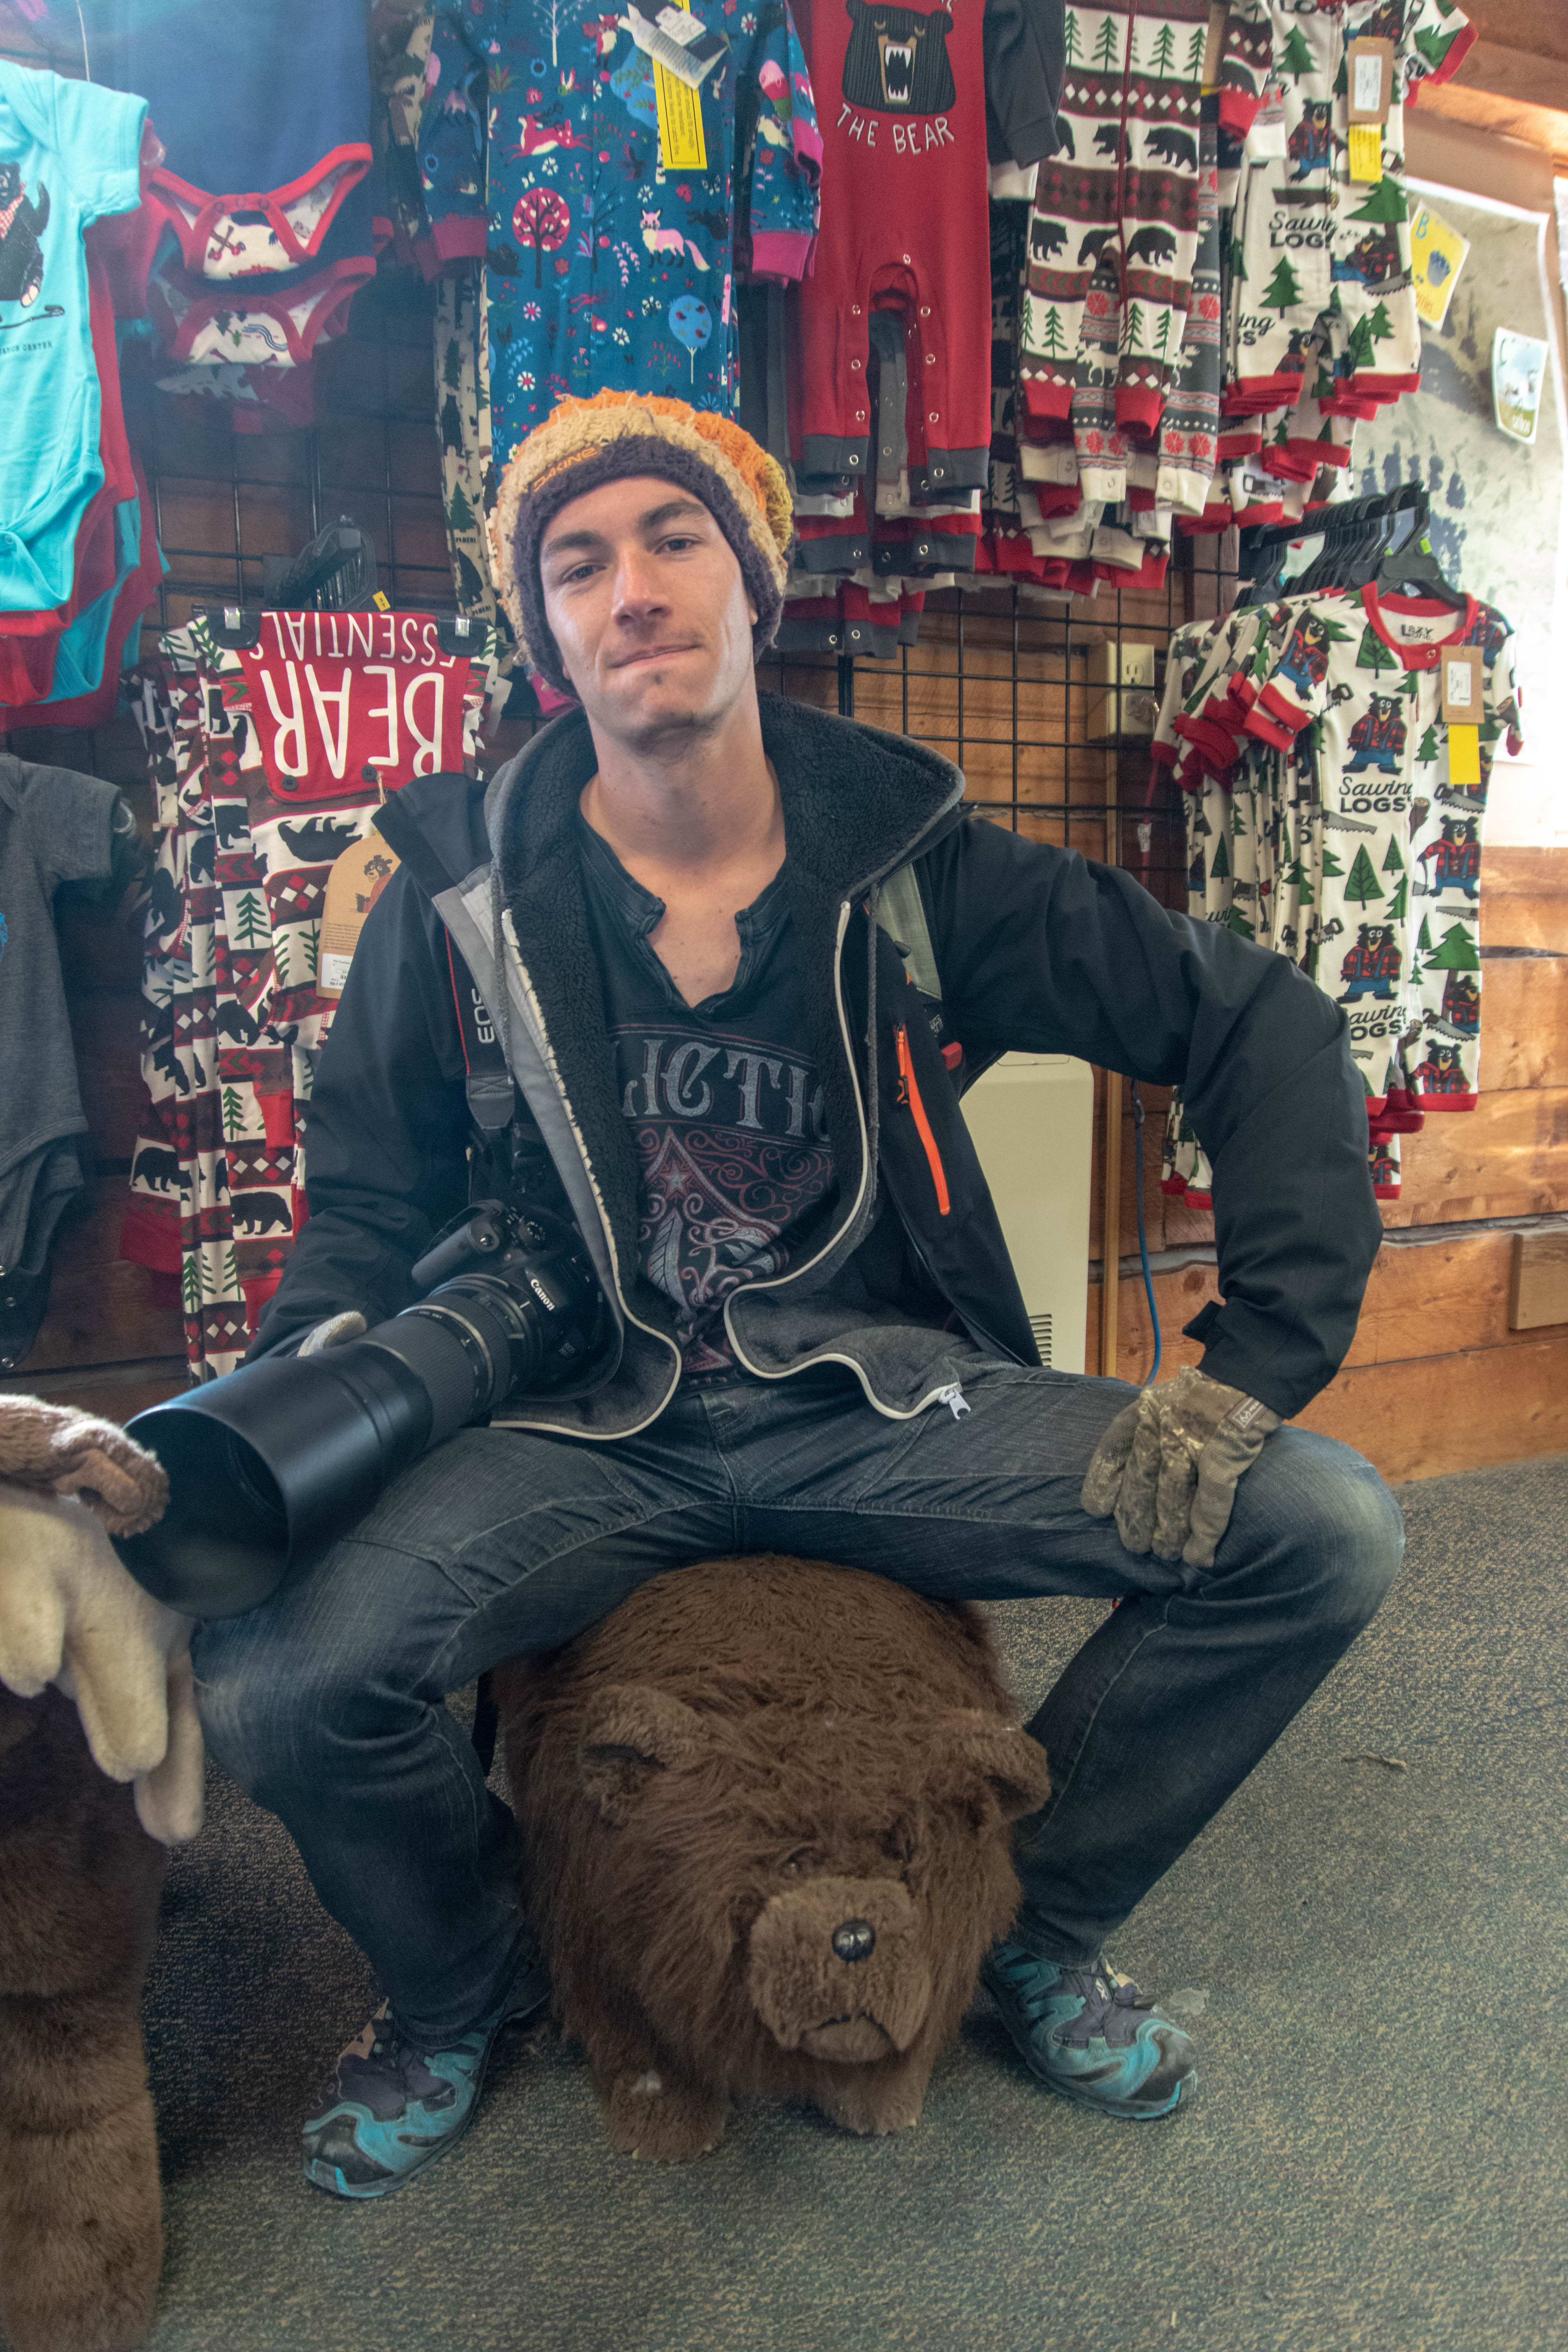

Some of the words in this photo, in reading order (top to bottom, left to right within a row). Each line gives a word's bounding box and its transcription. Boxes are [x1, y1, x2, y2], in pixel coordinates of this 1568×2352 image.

[837, 102, 879, 147] THE
[893, 117, 955, 155] BEAR
[1415, 211, 1430, 240] B
[22, 340, 53, 352] CENTER
[260, 661, 445, 779] BEAR
[1340, 797, 1407, 813] LOGS
[1349, 1004, 1407, 1025] awin
[1350, 1019, 1403, 1041] OGS
[530, 1278, 555, 1311] Canon
